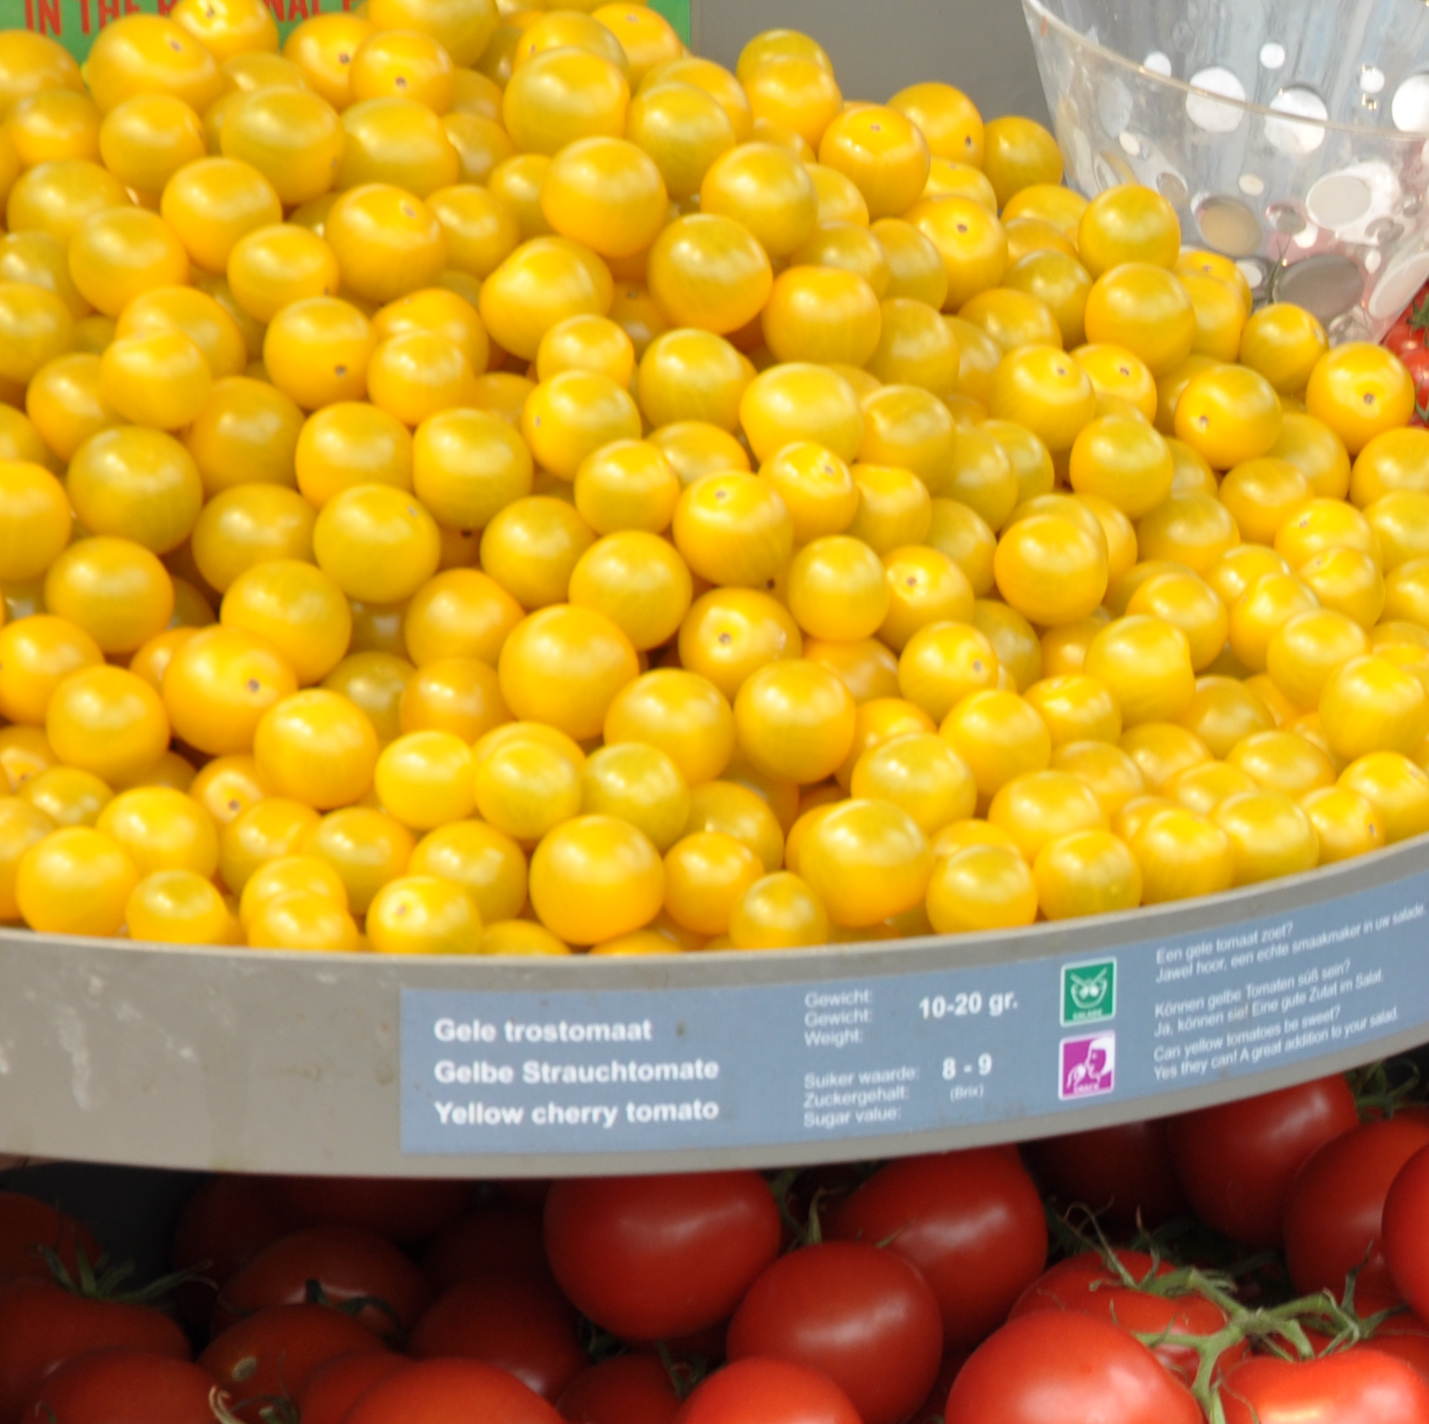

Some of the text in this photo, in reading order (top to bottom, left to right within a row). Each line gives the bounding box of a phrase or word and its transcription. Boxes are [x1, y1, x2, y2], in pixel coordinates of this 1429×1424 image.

[919, 991, 1019, 1019] 10-20 gr.
[433, 1018, 653, 1043] Gele trostomaat
[433, 1060, 720, 1084] Gelbe Strauchtomate
[941, 1057, 958, 1080] 8
[977, 1052, 994, 1076] 9
[434, 1100, 720, 1128] Yellow cherry tomato
